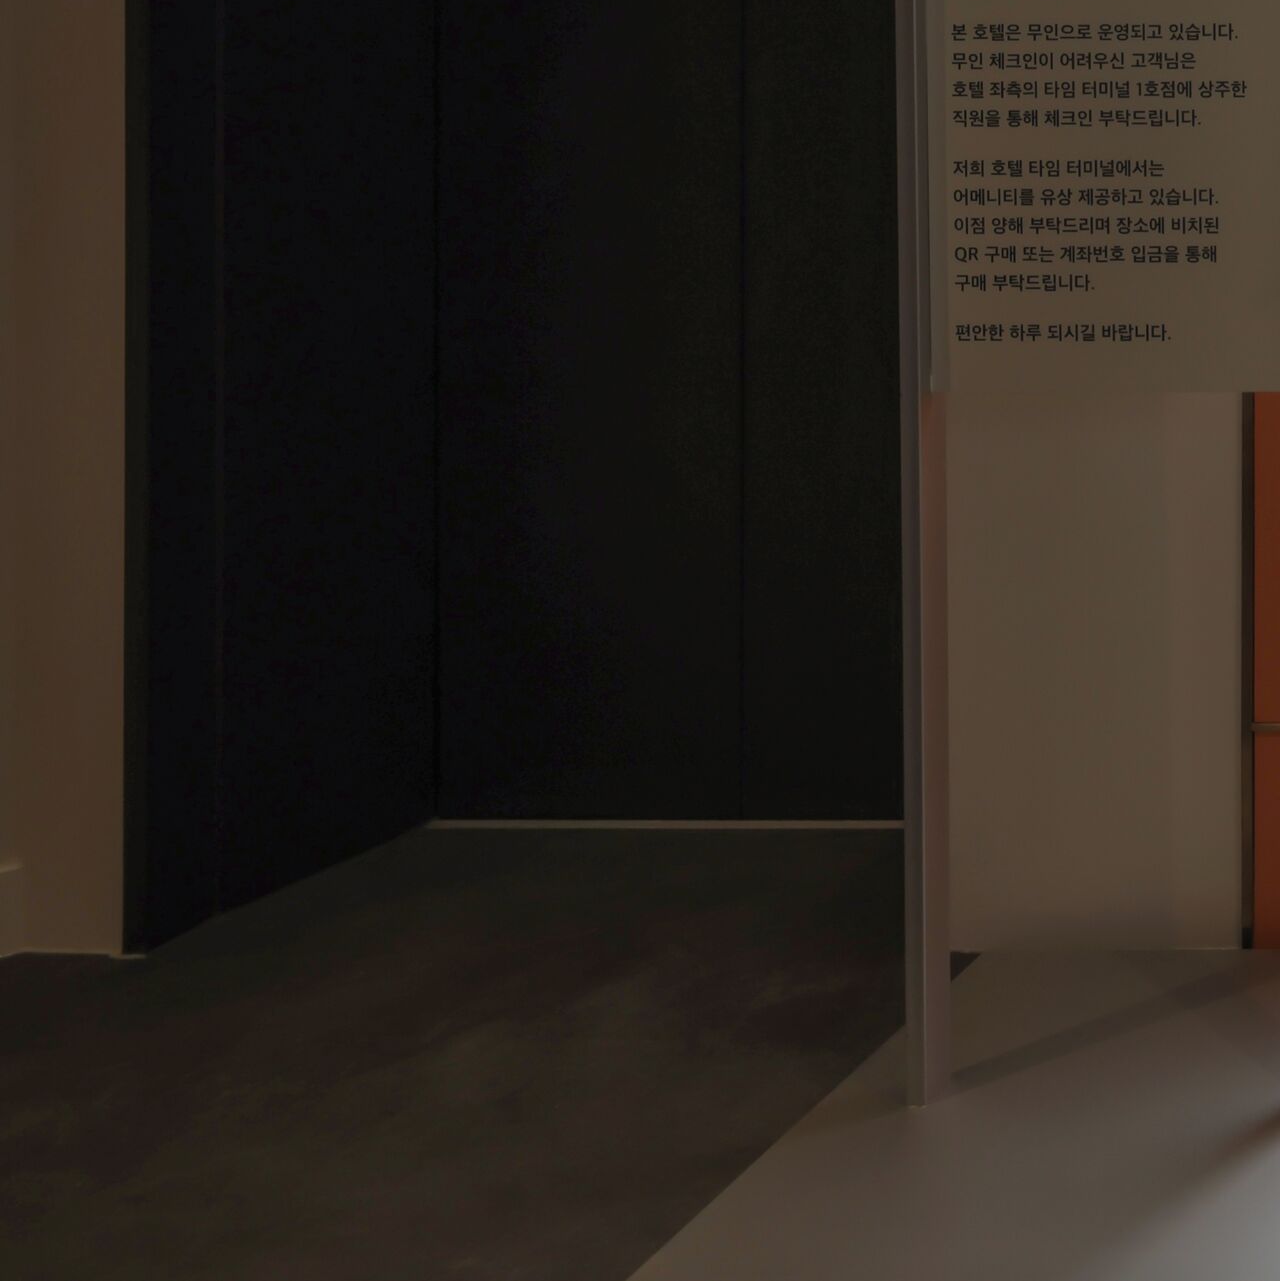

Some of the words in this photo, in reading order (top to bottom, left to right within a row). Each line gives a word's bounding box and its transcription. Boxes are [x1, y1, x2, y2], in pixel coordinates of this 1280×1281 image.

[951, 24, 967, 41] 본
[973, 23, 1021, 42] 호텔은
[1027, 24, 1092, 41] 무인으로
[1097, 23, 1163, 41] 운영되고
[1168, 23, 1238, 41] 있습니다.
[952, 52, 983, 70] 무인
[989, 52, 1053, 70] 체크인이
[1060, 52, 1124, 70] 어려우신
[1131, 52, 1196, 70] 고객님은
[952, 81, 984, 99] 호텔
[989, 81, 1038, 99] 좌측의
[1044, 80, 1075, 99] 타임
[1082, 80, 1130, 99] 터미널
[1136, 80, 1192, 98] 1호점에
[1198, 80, 1247, 98] 상주한
[953, 109, 1001, 128] 직원을
[1006, 109, 1038, 128] 통해
[1044, 109, 1092, 128] 체크인
[1098, 109, 1201, 127] 부탁드립니다.
[953, 160, 984, 177] 저희
[991, 160, 1023, 178] 호텔
[1029, 159, 1060, 178] 타임
[1066, 159, 1165, 177] 터미널에서는
[953, 188, 1035, 206] 어메니티를
[1040, 188, 1073, 206] 유상
[1078, 188, 1144, 206] 제공하고
[1149, 188, 1218, 206] 있습니다.
[954, 217, 985, 235] 이점
[991, 217, 1023, 235] 양해
[1029, 216, 1110, 235] 부탁드리며
[1116, 216, 1165, 235] 장소에
[1171, 216, 1219, 235] 비치된
[954, 246, 978, 263] QR
[984, 245, 1016, 263] 구매
[1022, 246, 1055, 263] 또는
[1060, 245, 1125, 264] 계좌번호
[1131, 245, 1180, 263] 입금을
[1185, 245, 1217, 263] 통해
[955, 274, 986, 292] 구매
[992, 274, 1095, 292] 부탁드립니다.
[955, 324, 1004, 342] 편안한
[1009, 324, 1042, 342] 하루
[1047, 324, 1095, 342] 되시길
[1102, 324, 1171, 342] 바랍니다.
